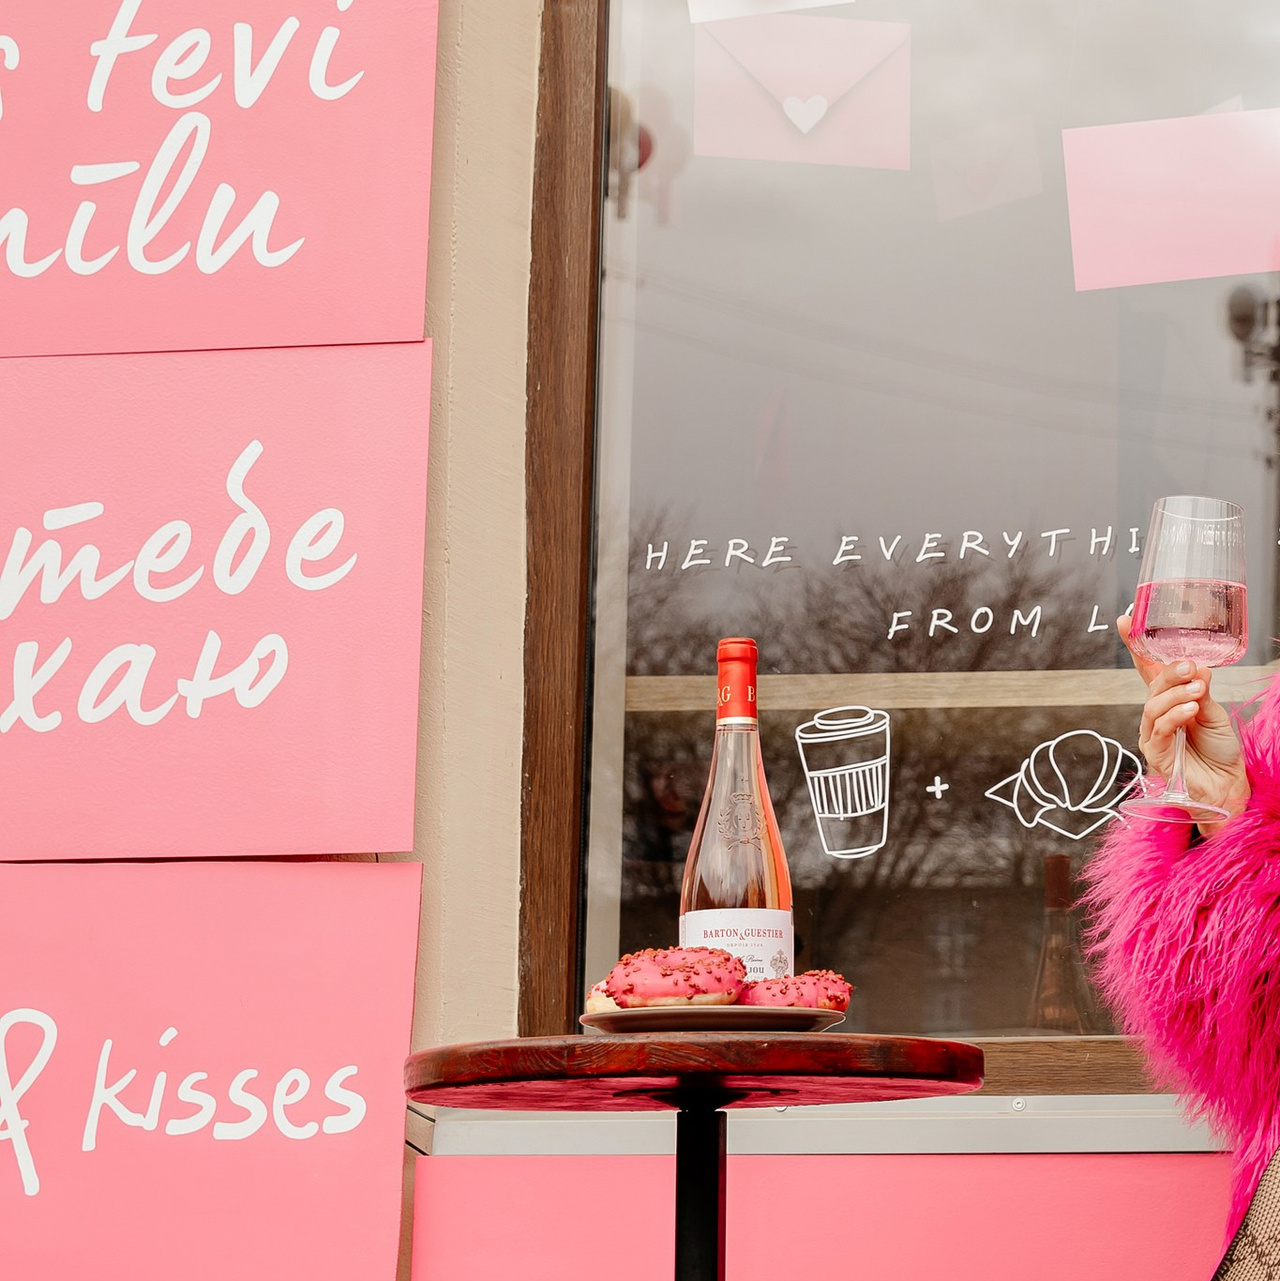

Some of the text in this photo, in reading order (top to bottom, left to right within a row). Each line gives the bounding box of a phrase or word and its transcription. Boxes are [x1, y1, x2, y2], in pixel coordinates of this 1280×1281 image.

[0, 439, 358, 620] тебе
[645, 536, 792, 570] HERE
[832, 525, 1140, 566] EVERYTHI
[887, 605, 1042, 640] FROM
[81, 1026, 367, 1152] kisses
